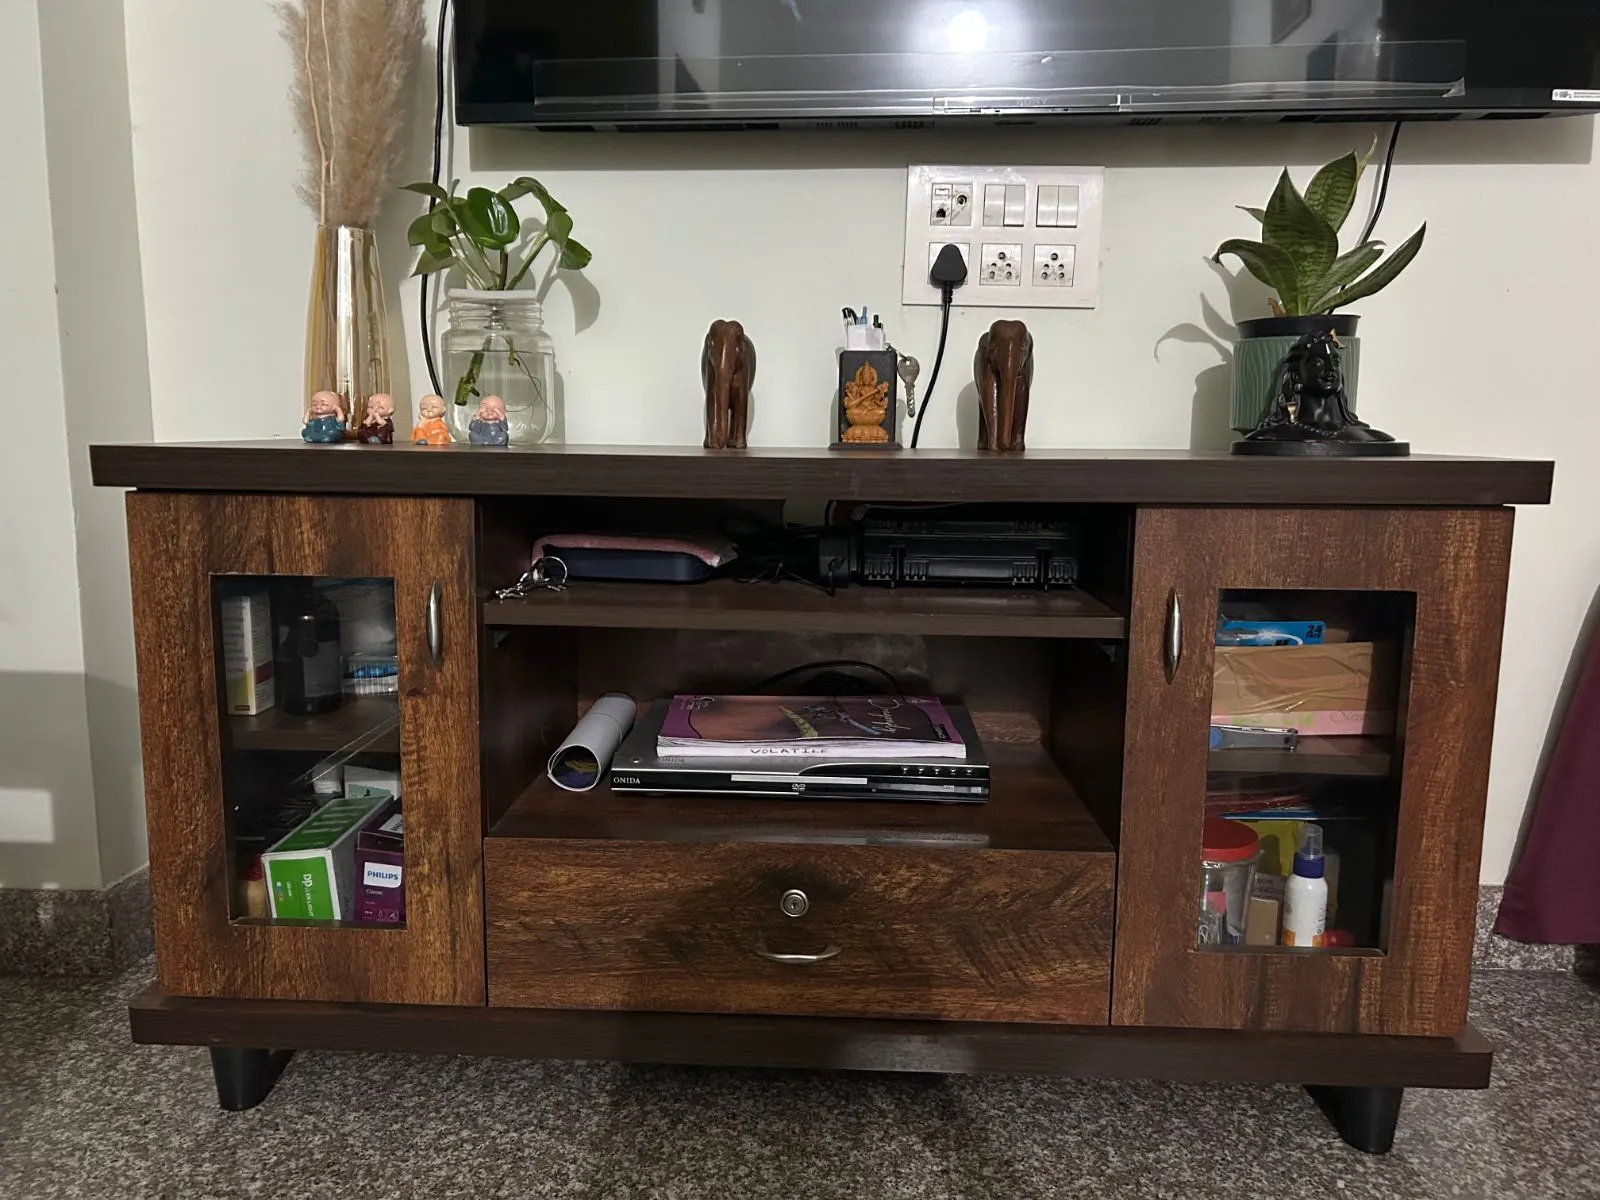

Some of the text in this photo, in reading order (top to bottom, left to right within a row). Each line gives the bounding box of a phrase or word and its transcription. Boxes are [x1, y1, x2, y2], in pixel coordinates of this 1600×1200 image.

[1307, 624, 1322, 633] 24
[613, 776, 641, 784] ONIDA
[367, 870, 399, 880] PHILIPS
